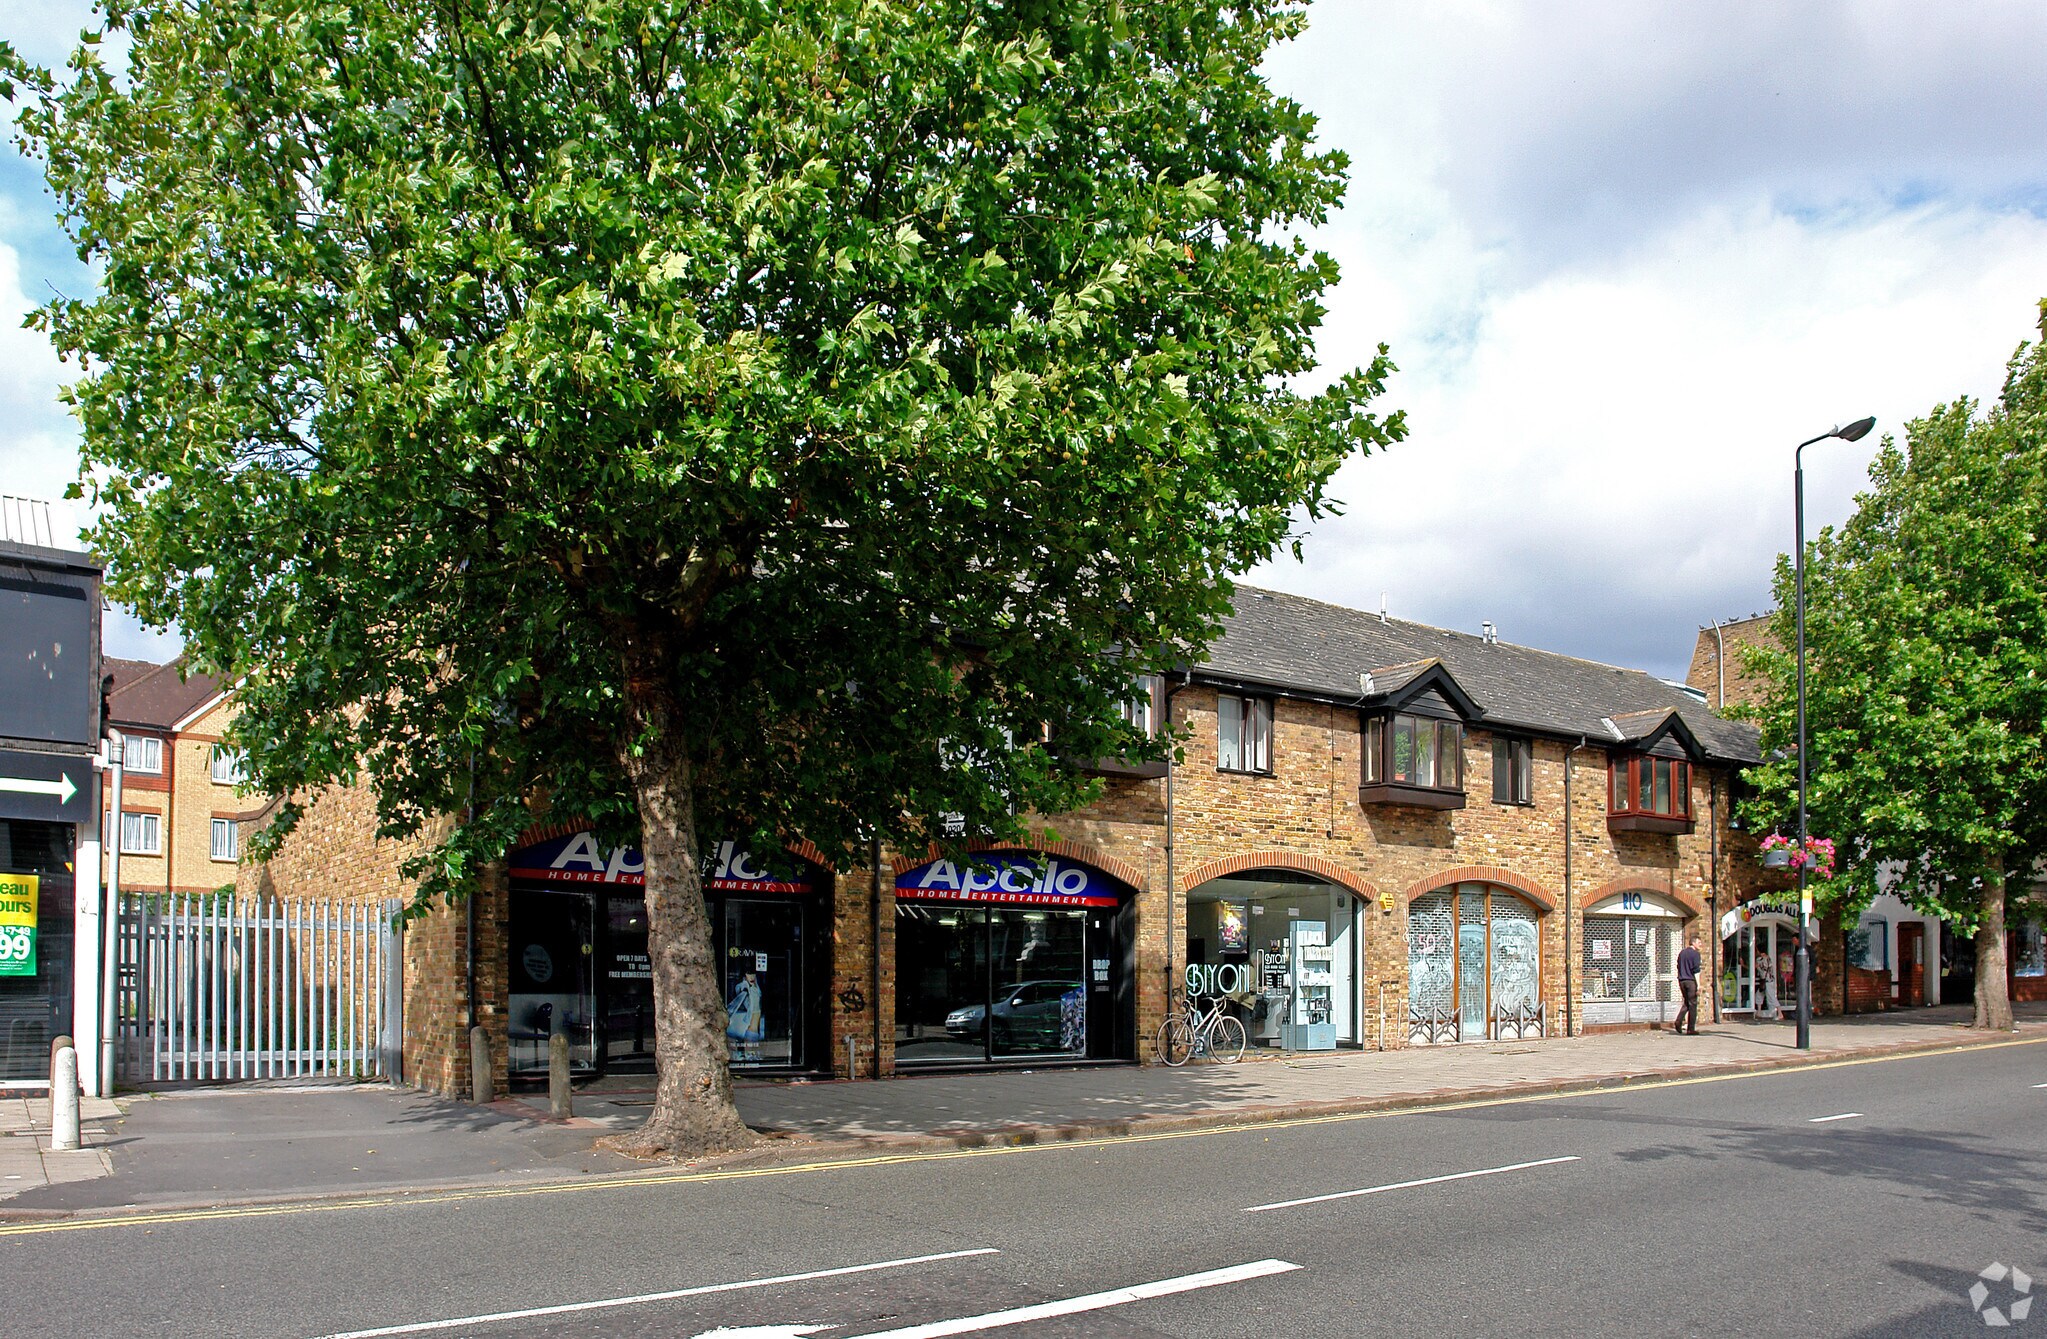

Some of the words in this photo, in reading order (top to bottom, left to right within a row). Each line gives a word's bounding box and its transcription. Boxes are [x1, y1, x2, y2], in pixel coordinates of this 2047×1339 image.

[550, 832, 770, 882] Aplo
[548, 871, 601, 882] HOME
[621, 875, 771, 892] ENNMENT
[917, 889, 958, 899] HOME
[972, 893, 1087, 905] ENTERTAINMENT
[1623, 892, 1642, 910] RIO
[1749, 903, 1783, 917] DOUGLAS
[1093, 959, 1110, 970] DROP
[1094, 970, 1109, 981] BOX
